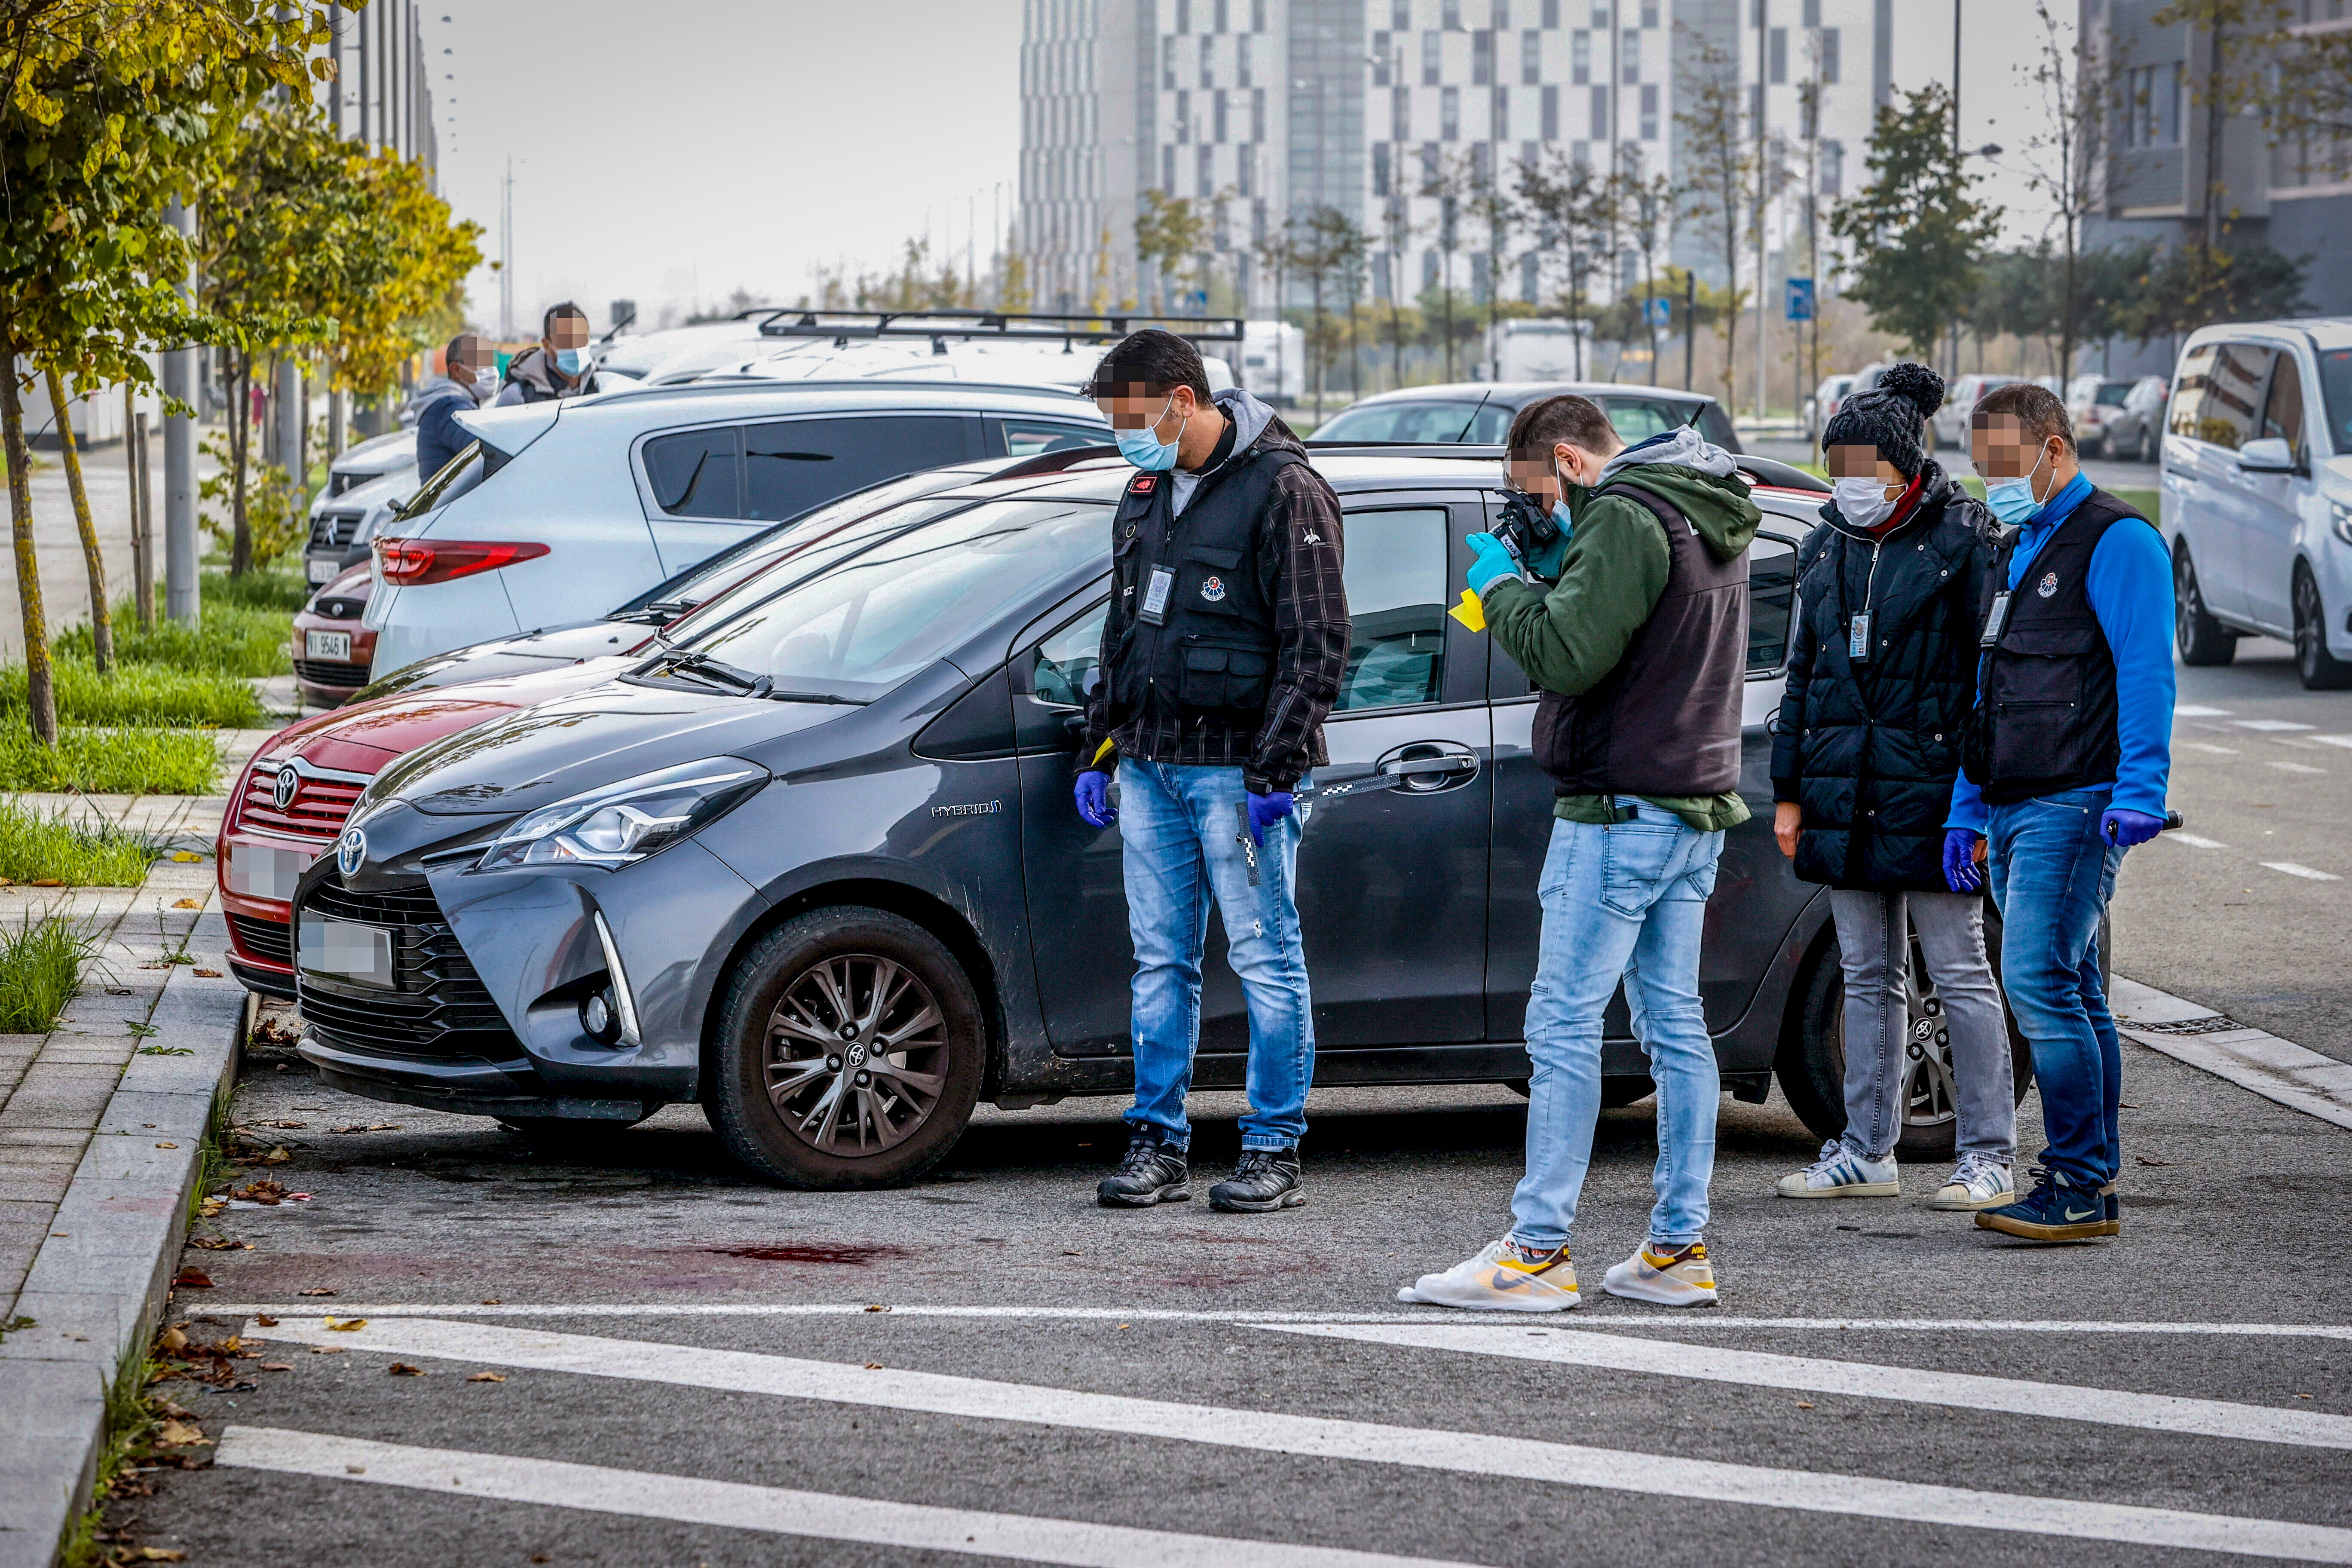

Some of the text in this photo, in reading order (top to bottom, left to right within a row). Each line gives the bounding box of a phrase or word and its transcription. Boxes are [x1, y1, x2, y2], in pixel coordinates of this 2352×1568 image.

[1503, 539, 1517, 554] ALAVA
[1202, 591, 1225, 600] ERTZAINTZA
[931, 803, 989, 817] HYBRID
[1691, 1246, 1706, 1255] NIKE
